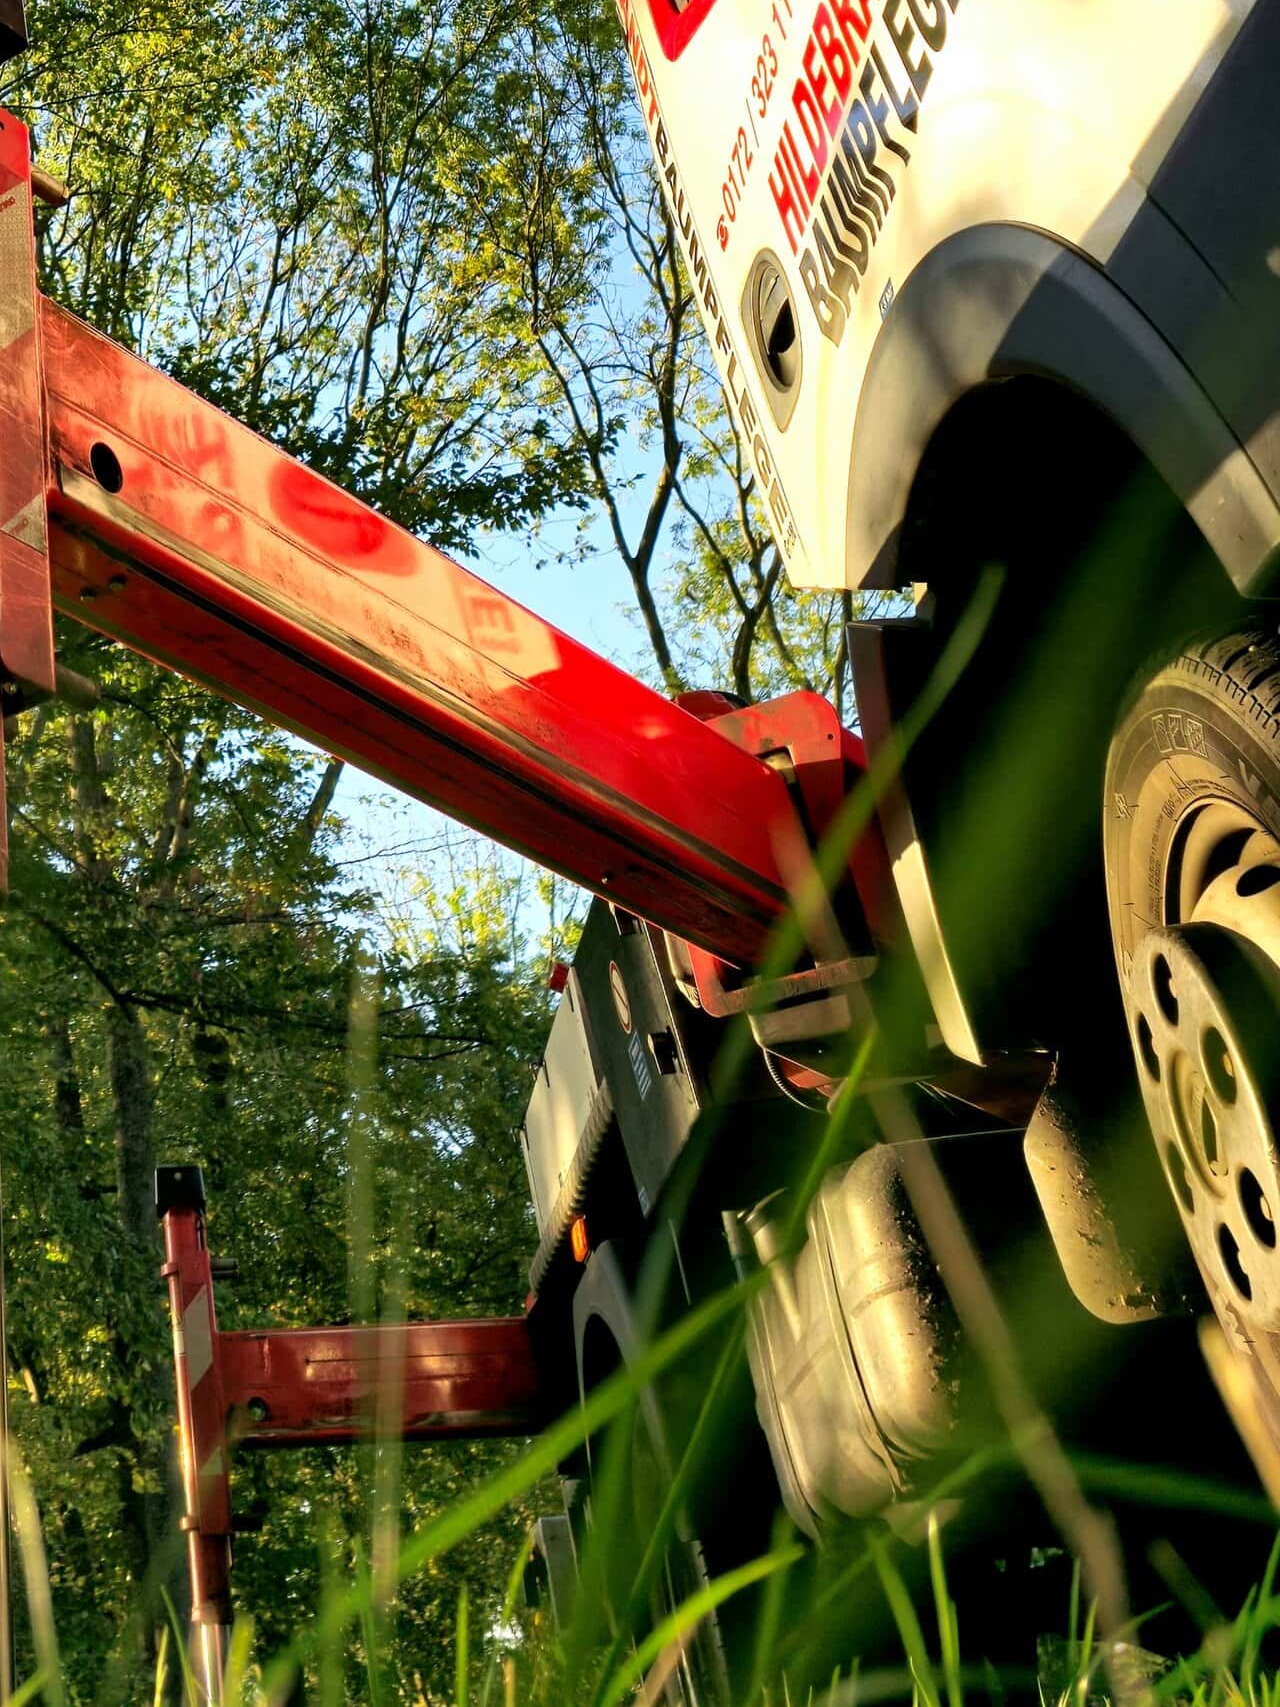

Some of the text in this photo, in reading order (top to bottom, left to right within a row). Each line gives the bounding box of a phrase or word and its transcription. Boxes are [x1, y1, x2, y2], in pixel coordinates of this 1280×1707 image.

[721, 125, 754, 223] 0172
[751, 33, 778, 119] 323
[654, 116, 788, 535] BAUMPFLEGE
